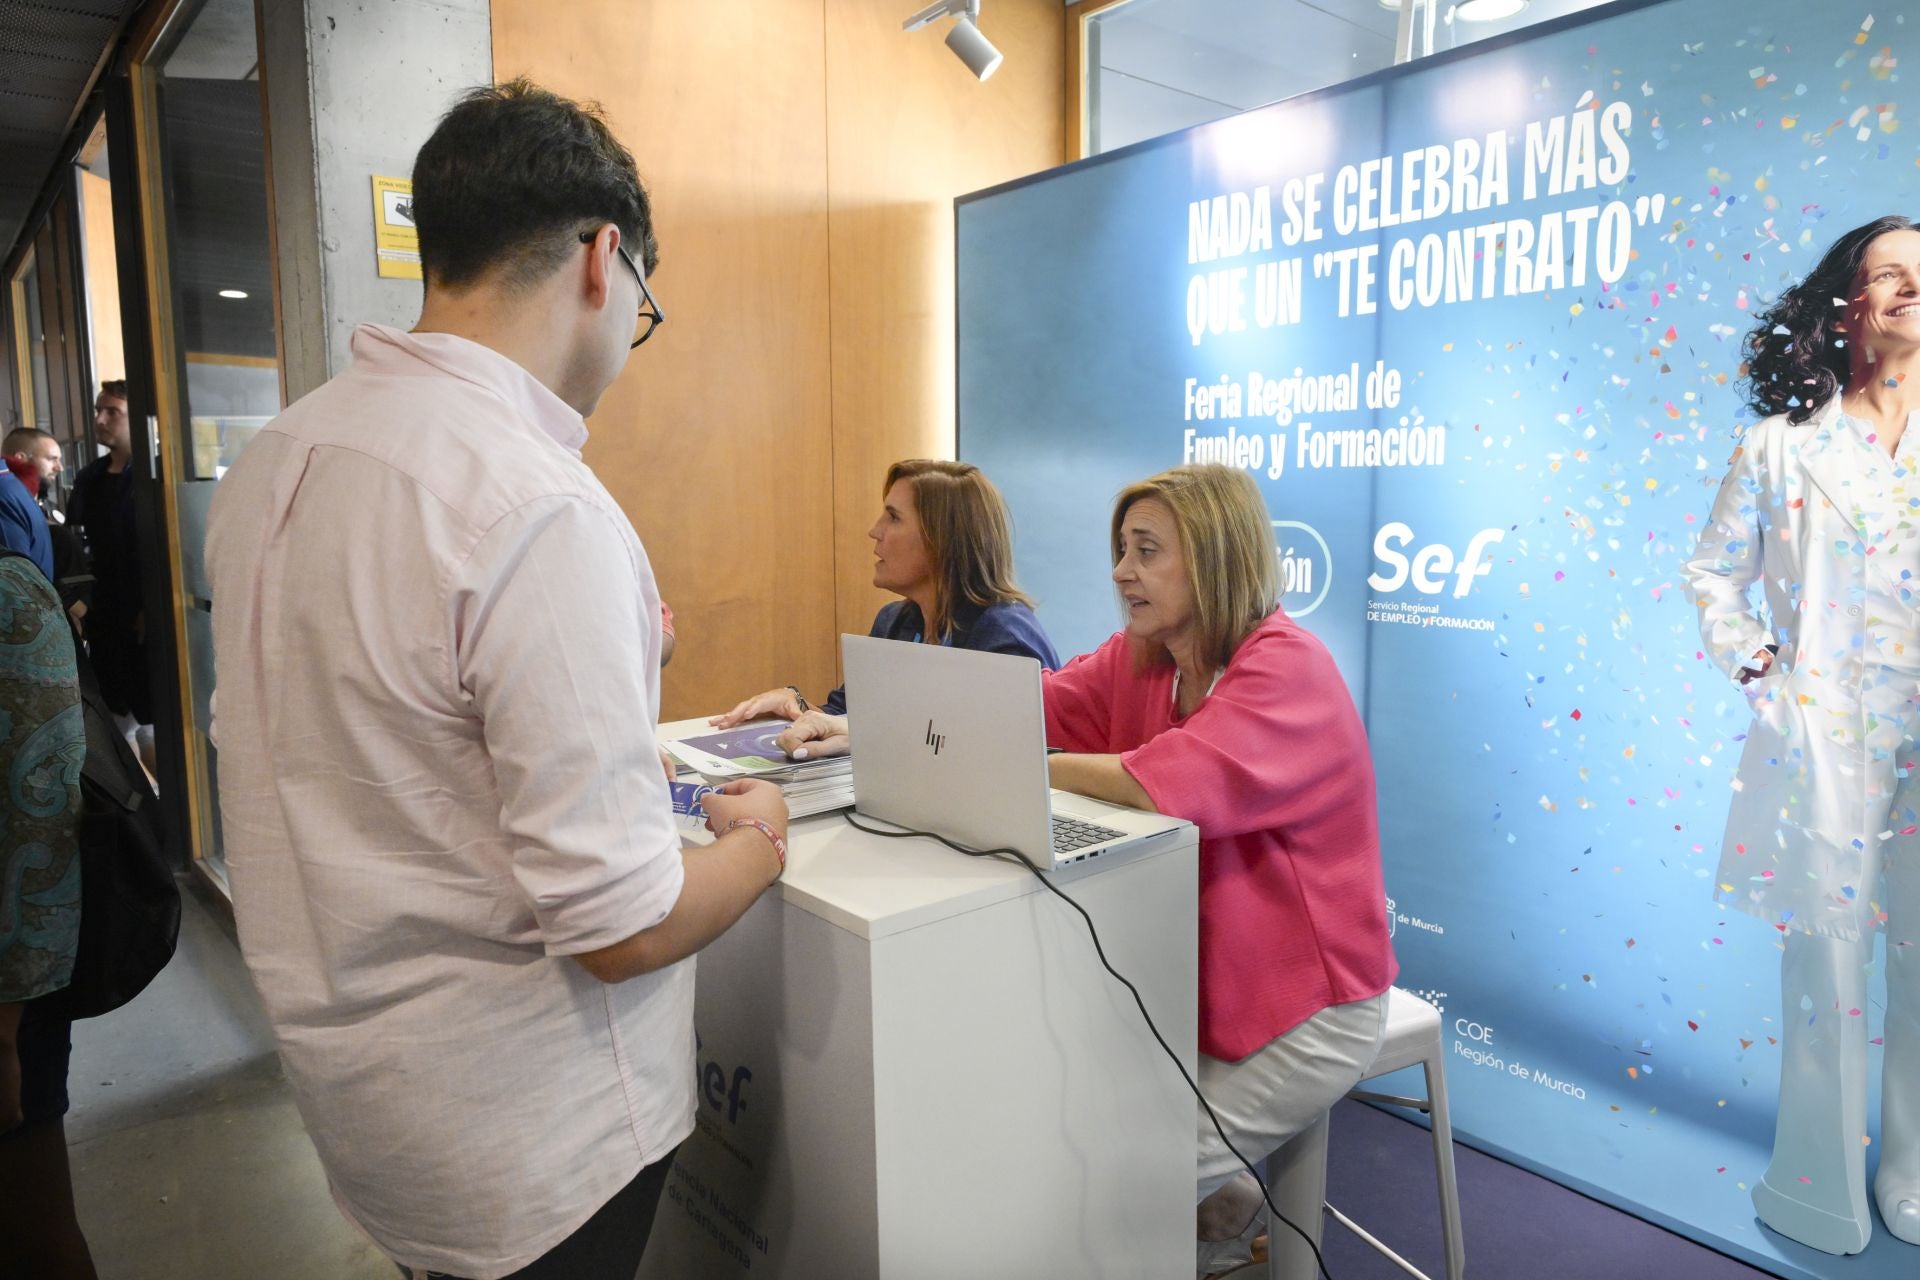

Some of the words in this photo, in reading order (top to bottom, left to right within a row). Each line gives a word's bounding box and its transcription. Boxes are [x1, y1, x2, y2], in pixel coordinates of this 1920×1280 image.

[1188, 184, 1272, 265] NADA
[1281, 171, 1324, 247] SE
[1332, 129, 1509, 236] CELEBRA
[1522, 90, 1633, 201] MÁS
[1186, 264, 1248, 346] QUE
[1254, 257, 1302, 329] UN
[1312, 243, 1379, 319] "TE
[1388, 193, 1667, 311] CONTRATO"
[1184, 373, 1242, 421] Feria
[1247, 362, 1359, 427] Regional
[1366, 359, 1402, 409] de
[1183, 426, 1264, 470] Empleo
[1267, 432, 1286, 480] y
[1297, 416, 1446, 469] Formación
[1366, 521, 1505, 599] Sef
[1367, 599, 1399, 611] Servicio
[1400, 602, 1440, 615] Regional
[1367, 611, 1380, 621] DE
[1381, 612, 1421, 625] EMPLEO
[1430, 616, 1496, 632] FORMACIÓN
[925, 719, 946, 755] hp
[1397, 913, 1410, 925] de
[1411, 916, 1444, 935] Murcia
[1455, 1018, 1494, 1046] COE
[699, 1050, 753, 1125] ef
[1454, 1040, 1505, 1071] Región
[1508, 1062, 1530, 1080] de
[1532, 1069, 1587, 1100] Murcia
[667, 1183, 683, 1206] de
[685, 1196, 751, 1270] Cartagena
[708, 1186, 769, 1256] Nacional
